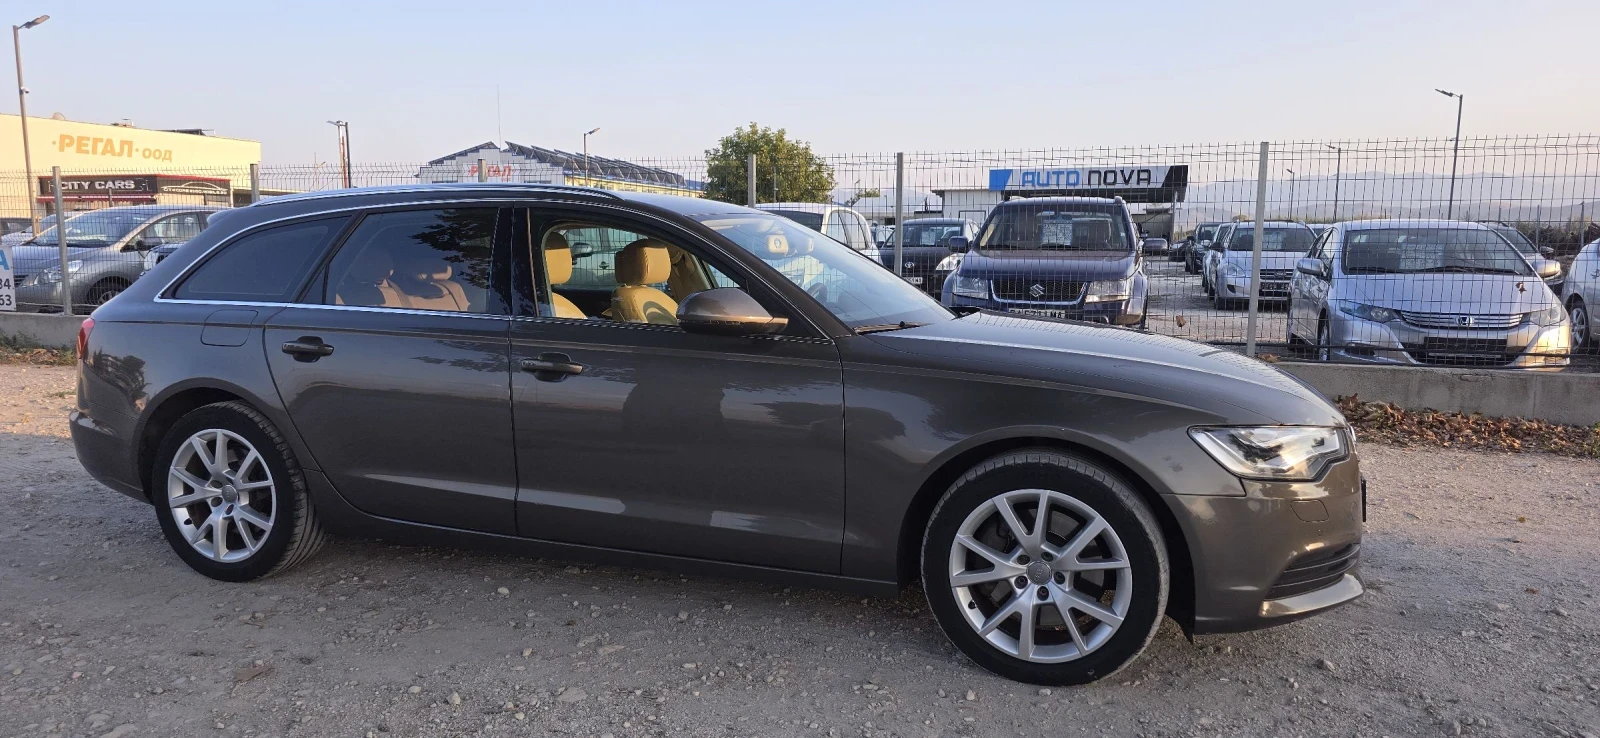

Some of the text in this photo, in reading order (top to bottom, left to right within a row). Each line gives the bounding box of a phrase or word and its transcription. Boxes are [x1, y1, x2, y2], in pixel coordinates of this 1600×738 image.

[58, 134, 134, 158] РЕГАЛ
[470, 165, 511, 176] РГАЛ
[60, 180, 135, 190] CITY CARS
[1021, 169, 1151, 187] AUTO NOVA
